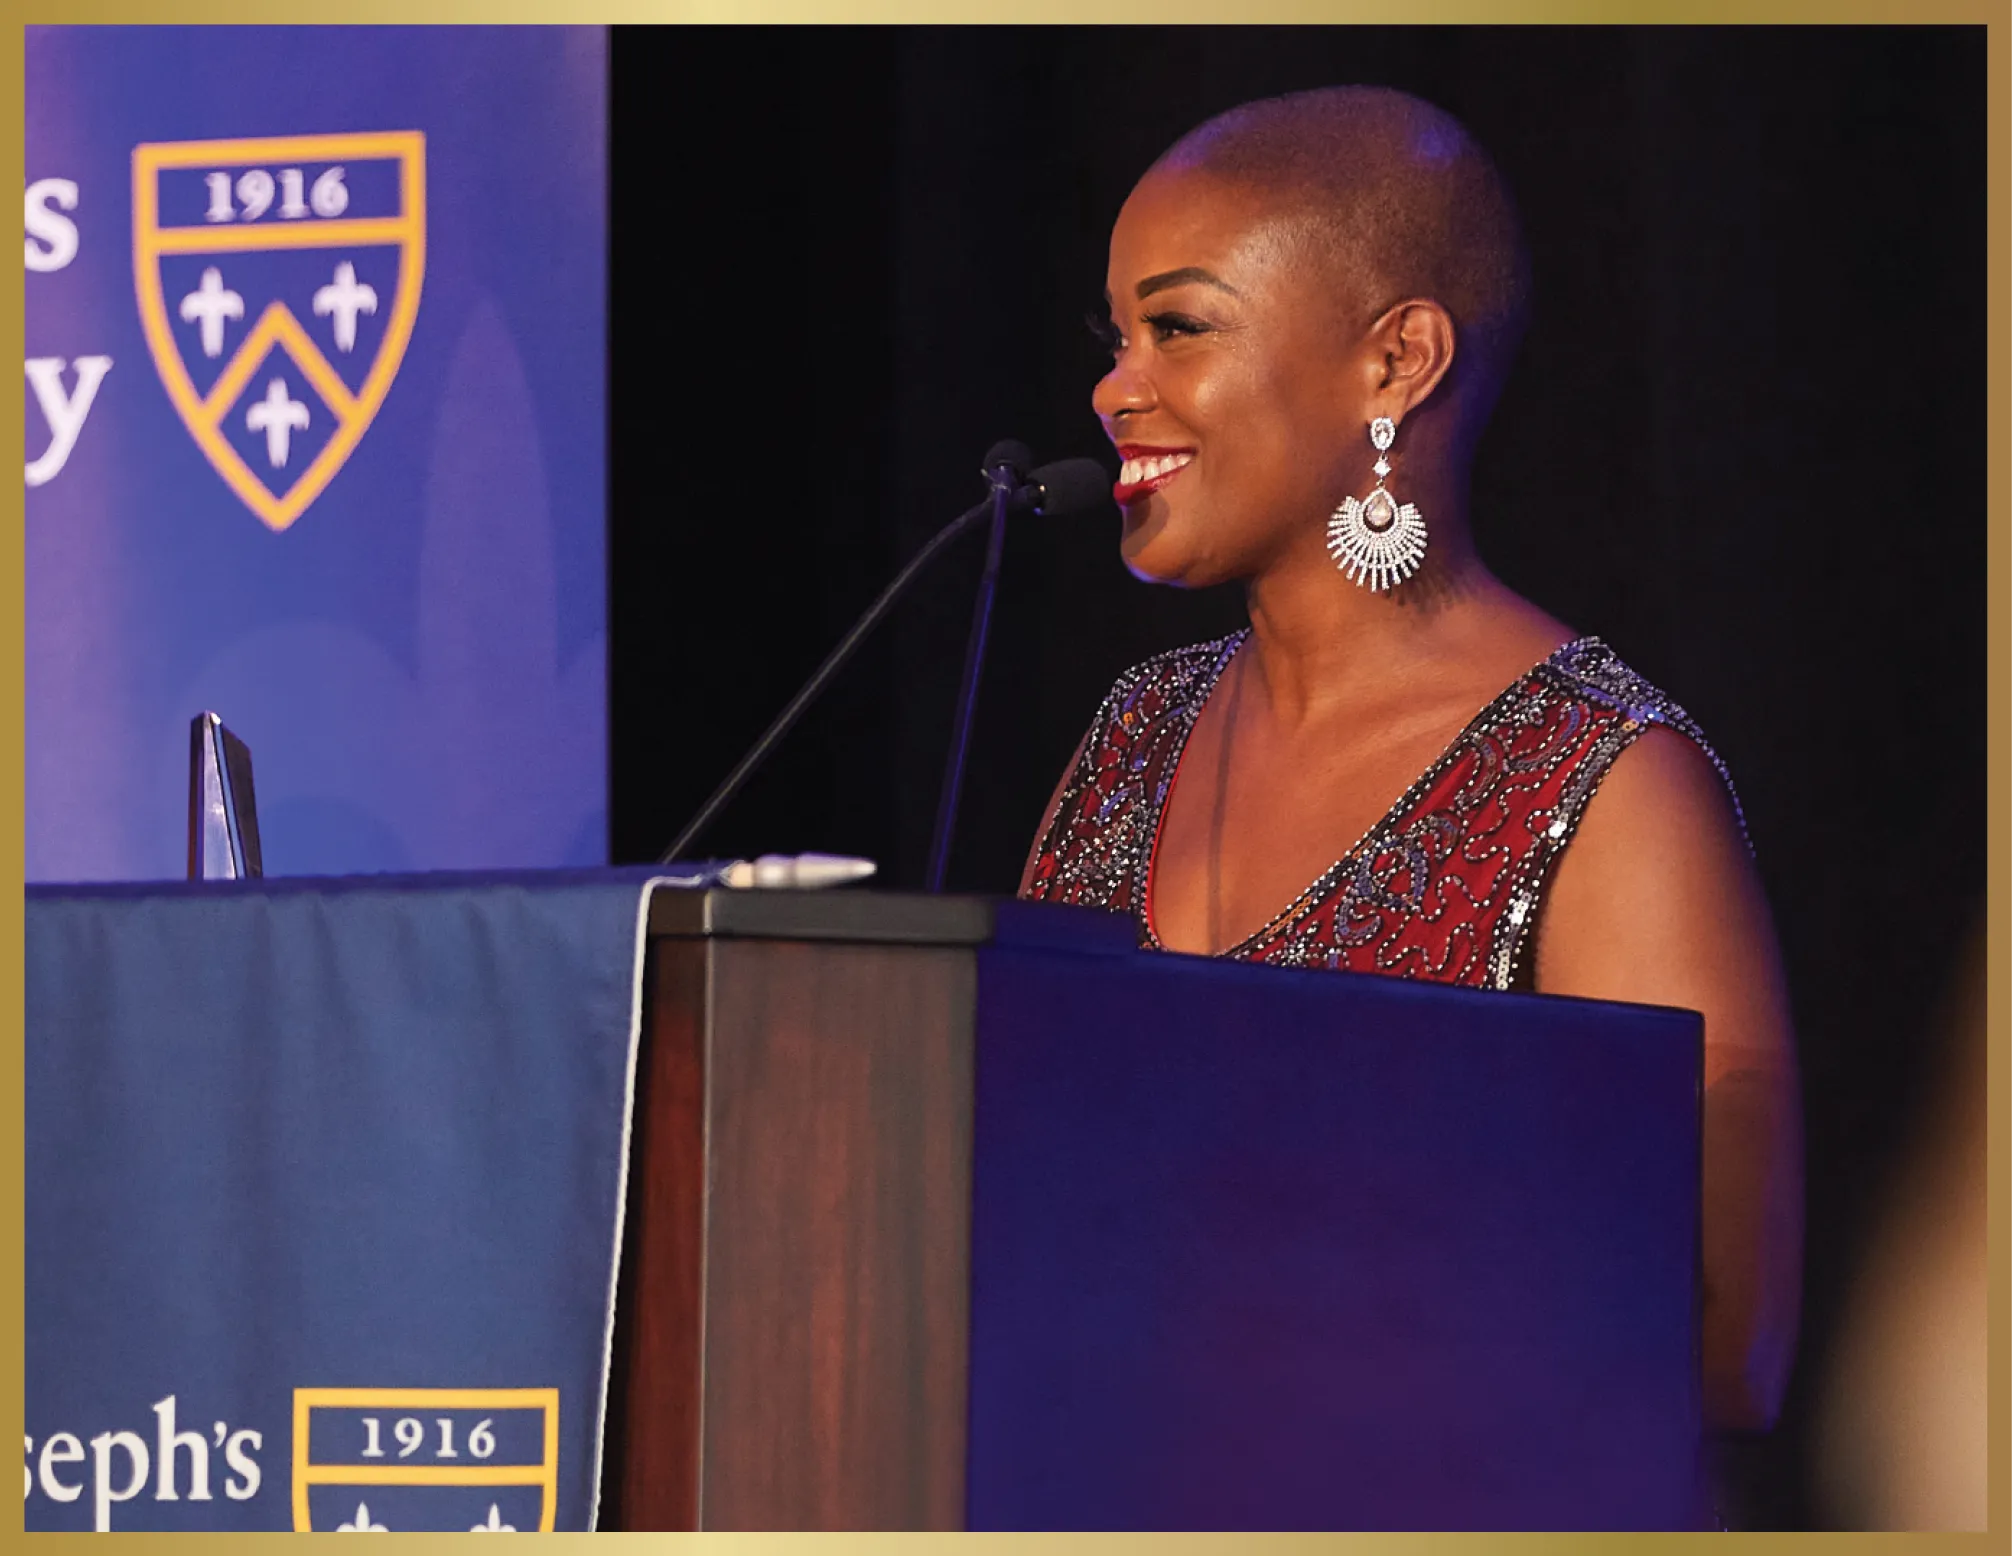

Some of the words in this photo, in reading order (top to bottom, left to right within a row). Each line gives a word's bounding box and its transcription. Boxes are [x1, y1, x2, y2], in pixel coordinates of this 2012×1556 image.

[204, 166, 349, 222] 1916
[25, 1395, 262, 1532] eph's
[362, 1418, 496, 1459] 1916
